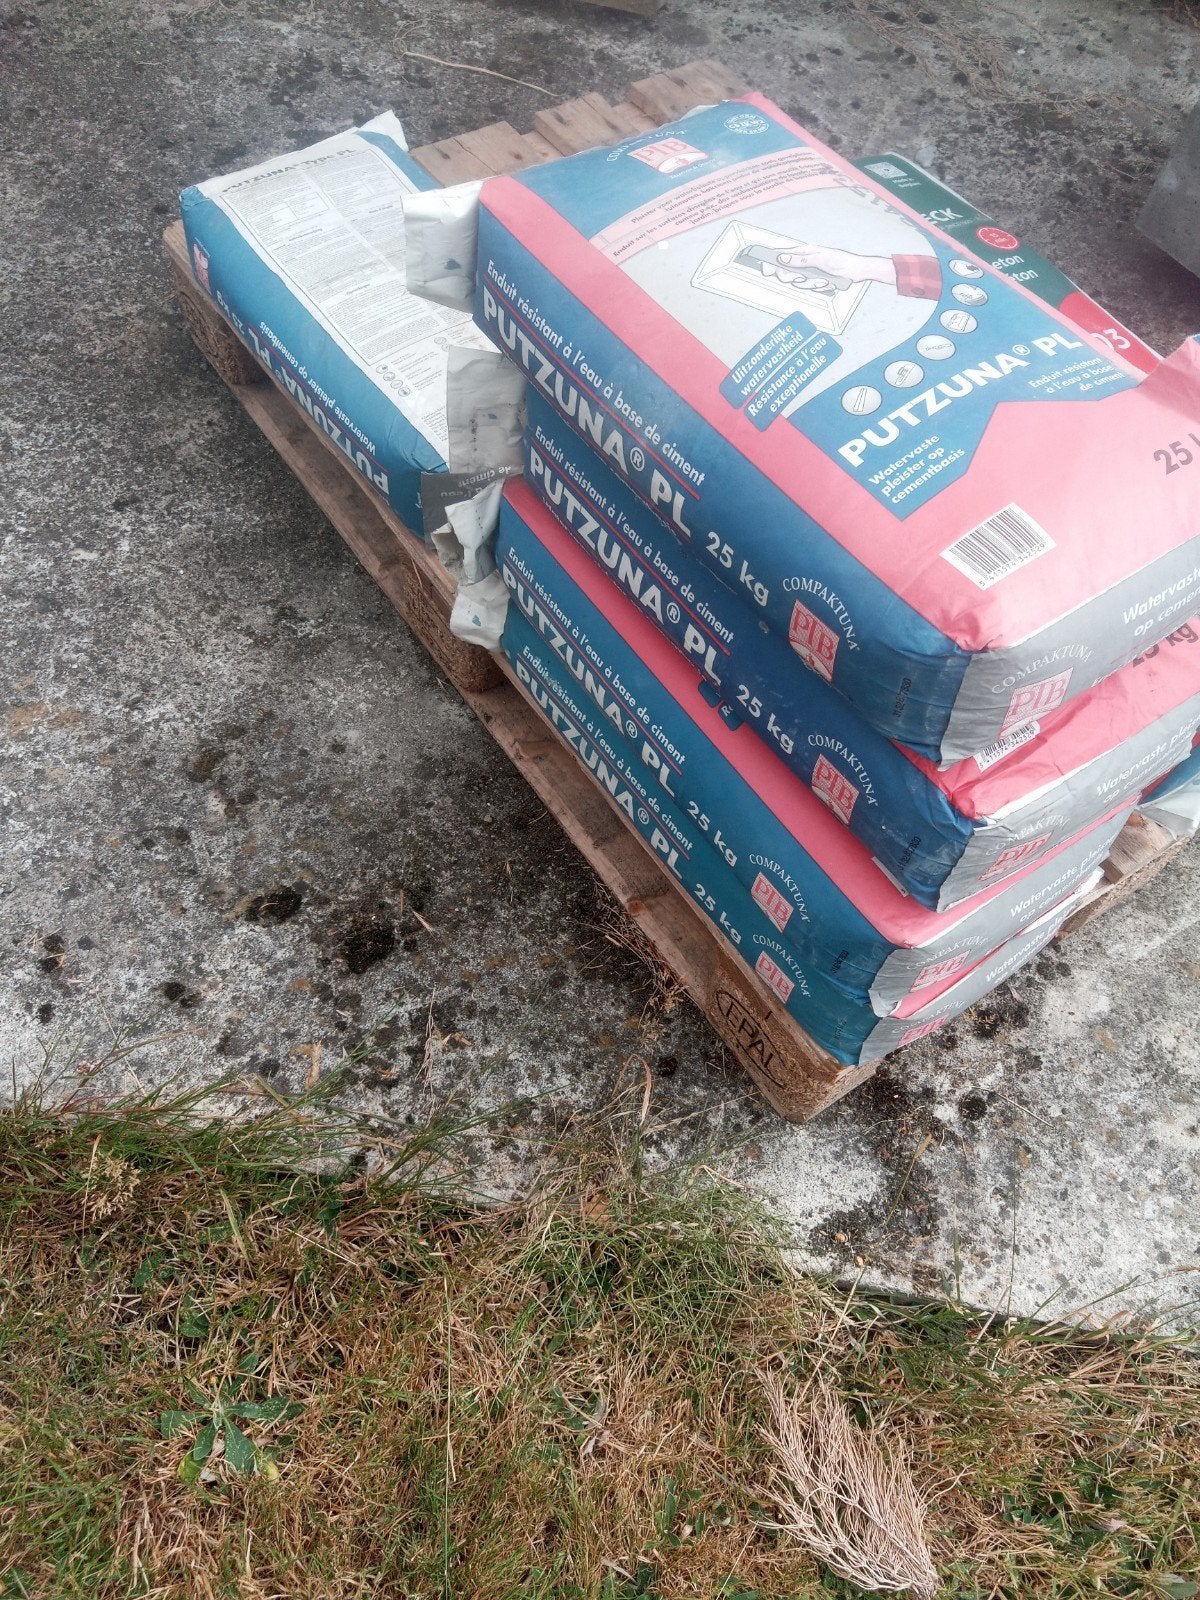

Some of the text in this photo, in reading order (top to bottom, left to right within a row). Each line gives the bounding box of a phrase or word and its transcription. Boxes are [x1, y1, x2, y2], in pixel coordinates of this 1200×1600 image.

[634, 141, 688, 162] PIB
[612, 240, 635, 258] Enduit
[635, 232, 647, 242] sur
[658, 211, 686, 229] surfaces
[674, 212, 699, 226] comme
[991, 255, 1025, 270] eton
[731, 325, 793, 384] Uitzonderlijke
[740, 331, 804, 396] watervastheid
[1031, 333, 1083, 357] PL
[259, 321, 376, 456] Watervaste pleister op cementbasis
[487, 259, 706, 487] Enduit résistant à l'eau à base de ciment
[747, 337, 827, 417] Résistance à l'eau
[769, 354, 827, 413] exceptionelle
[1028, 357, 1104, 388] Enduit résistant
[1044, 363, 1117, 394] à l'eau à base
[1078, 371, 1126, 392] de ciment
[868, 434, 941, 485] Watervaste
[880, 446, 946, 497] pleister op
[891, 448, 966, 504] cementbasis
[1153, 440, 1194, 475] 25
[650, 468, 692, 539] PL
[535, 425, 735, 644] Enduit résistant à l'eau à base de ciment
[705, 531, 770, 607] 25 kg
[792, 607, 835, 663] PIB
[1134, 618, 1155, 637] op
[508, 546, 687, 766] Enduit résistant à l'eau à base de ciment
[683, 622, 722, 687] PL
[736, 684, 794, 755] 25 kg
[1010, 675, 1067, 716] PIB
[522, 645, 694, 851] Enduit résistant à l'eau à base de ciment
[641, 740, 676, 798] PL
[1096, 742, 1167, 796] Watervaste
[815, 760, 855, 812] PIB
[650, 827, 683, 880] PL
[686, 800, 738, 868] 25 kg
[693, 883, 742, 945] 25 kg
[754, 876, 791, 924] PIB
[1010, 866, 1078, 917] Watervaste
[1019, 908, 1036, 922] op
[757, 952, 791, 998] PIB
[985, 931, 1045, 982] Watervaste
[725, 1001, 777, 1082] EPAL
